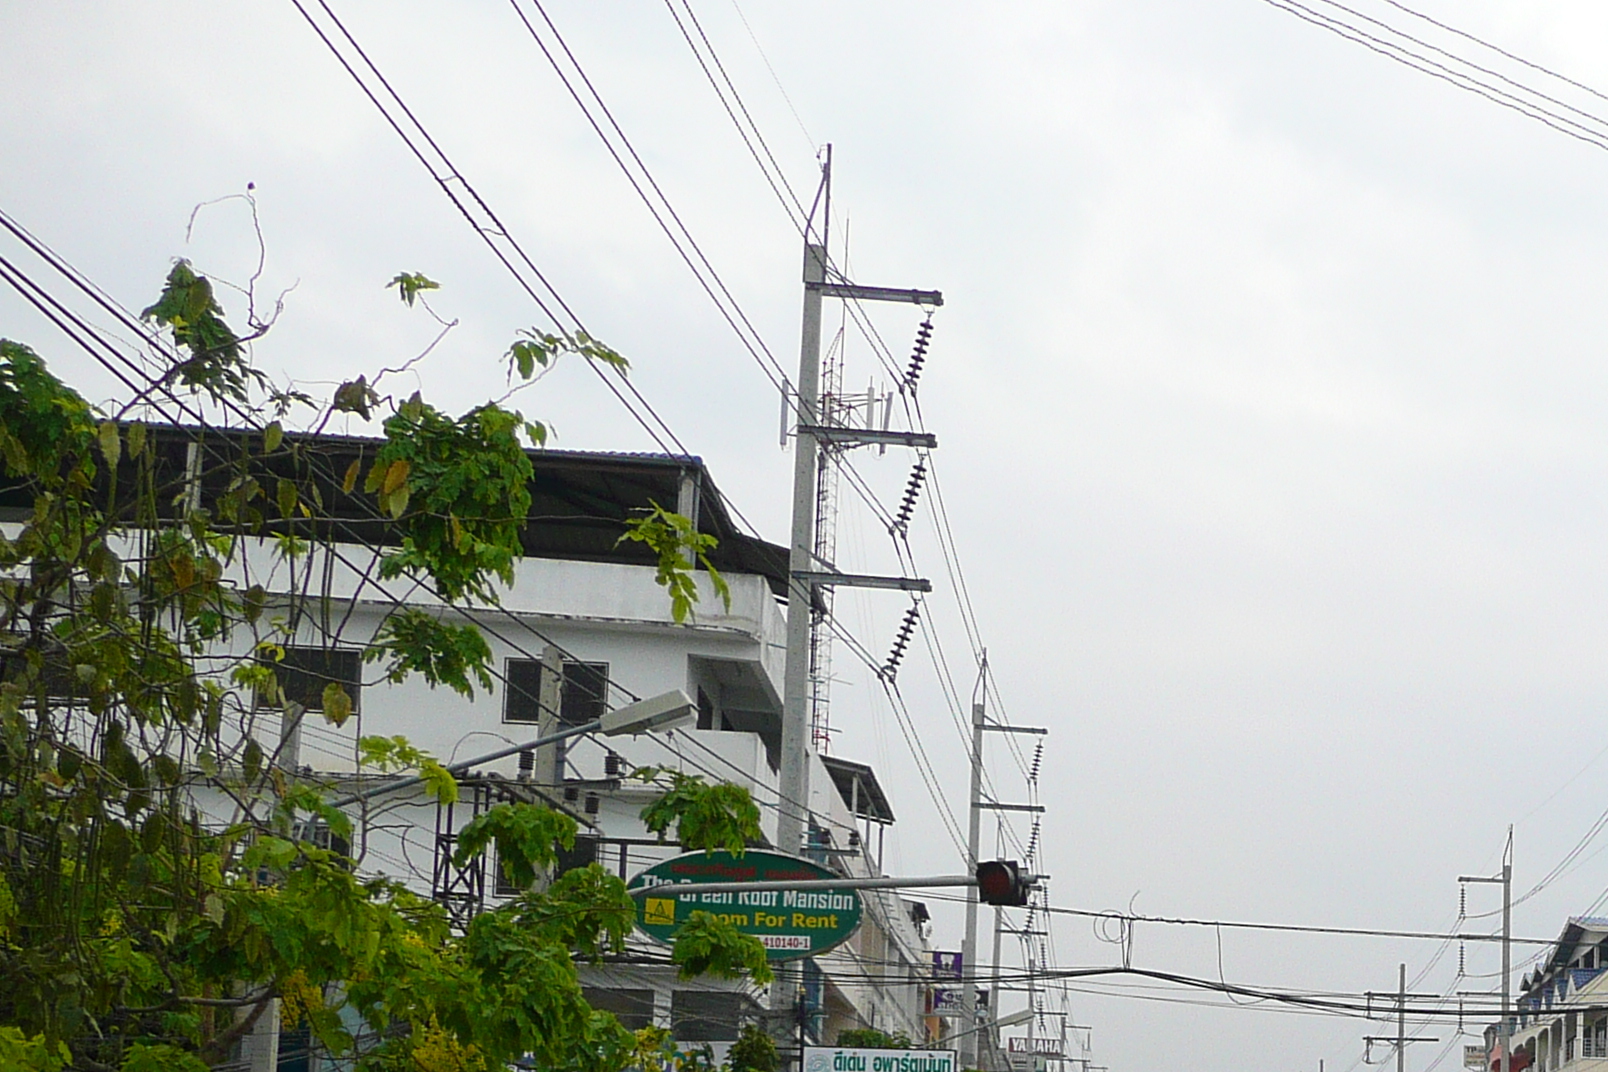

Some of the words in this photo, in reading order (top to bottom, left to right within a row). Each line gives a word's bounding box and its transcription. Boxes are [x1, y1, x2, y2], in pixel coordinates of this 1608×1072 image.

[783, 889, 853, 910] Mansion
[755, 912, 785, 927] For
[792, 913, 838, 929] Rent
[834, 1051, 866, 1072] ดีเด่น
